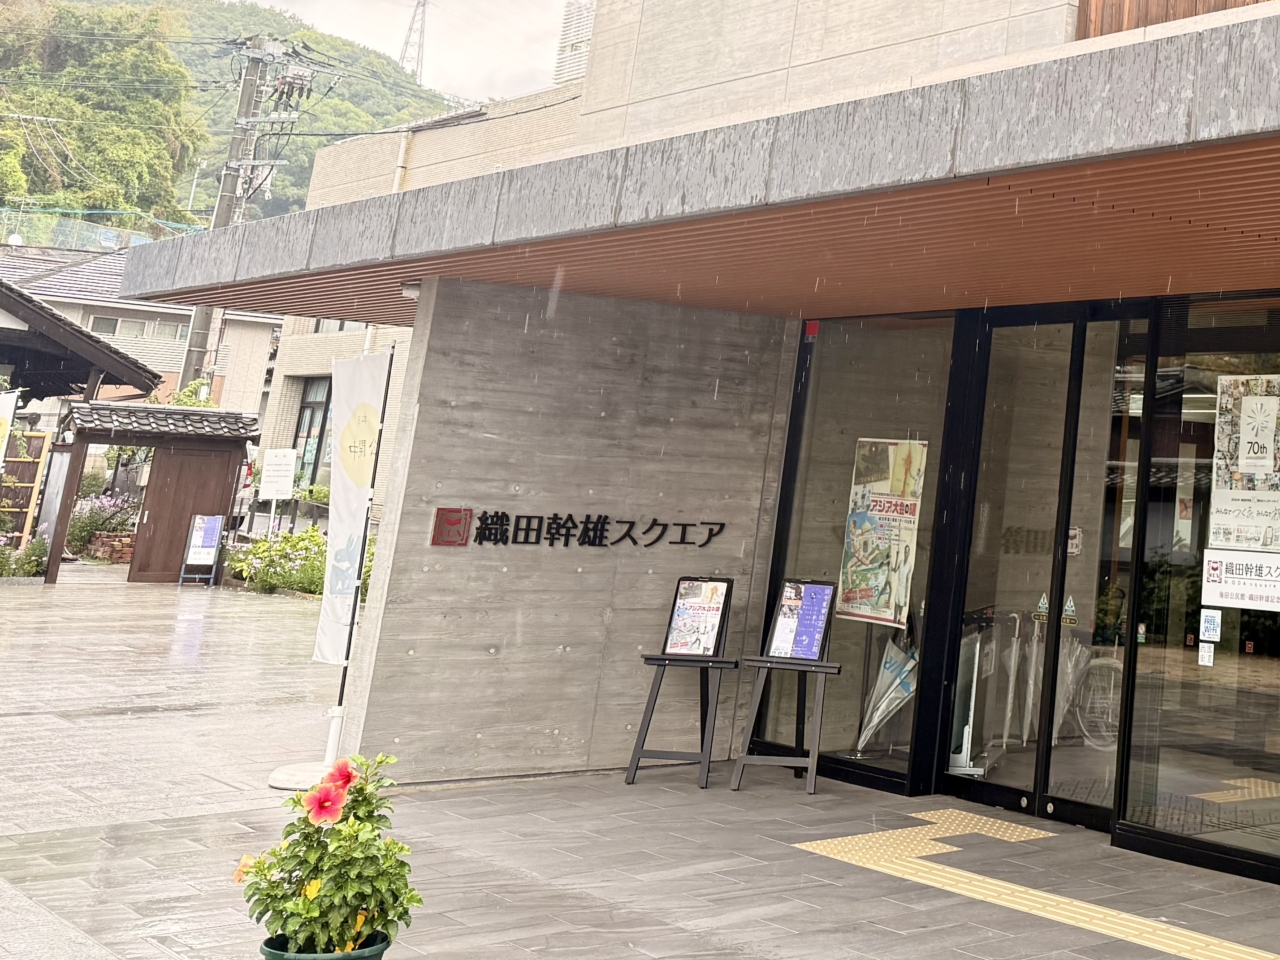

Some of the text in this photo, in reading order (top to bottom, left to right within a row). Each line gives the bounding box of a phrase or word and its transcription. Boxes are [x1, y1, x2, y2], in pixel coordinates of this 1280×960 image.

[1247, 441, 1268, 455] 70th
[473, 511, 725, 547] 織田幹雄スクエア
